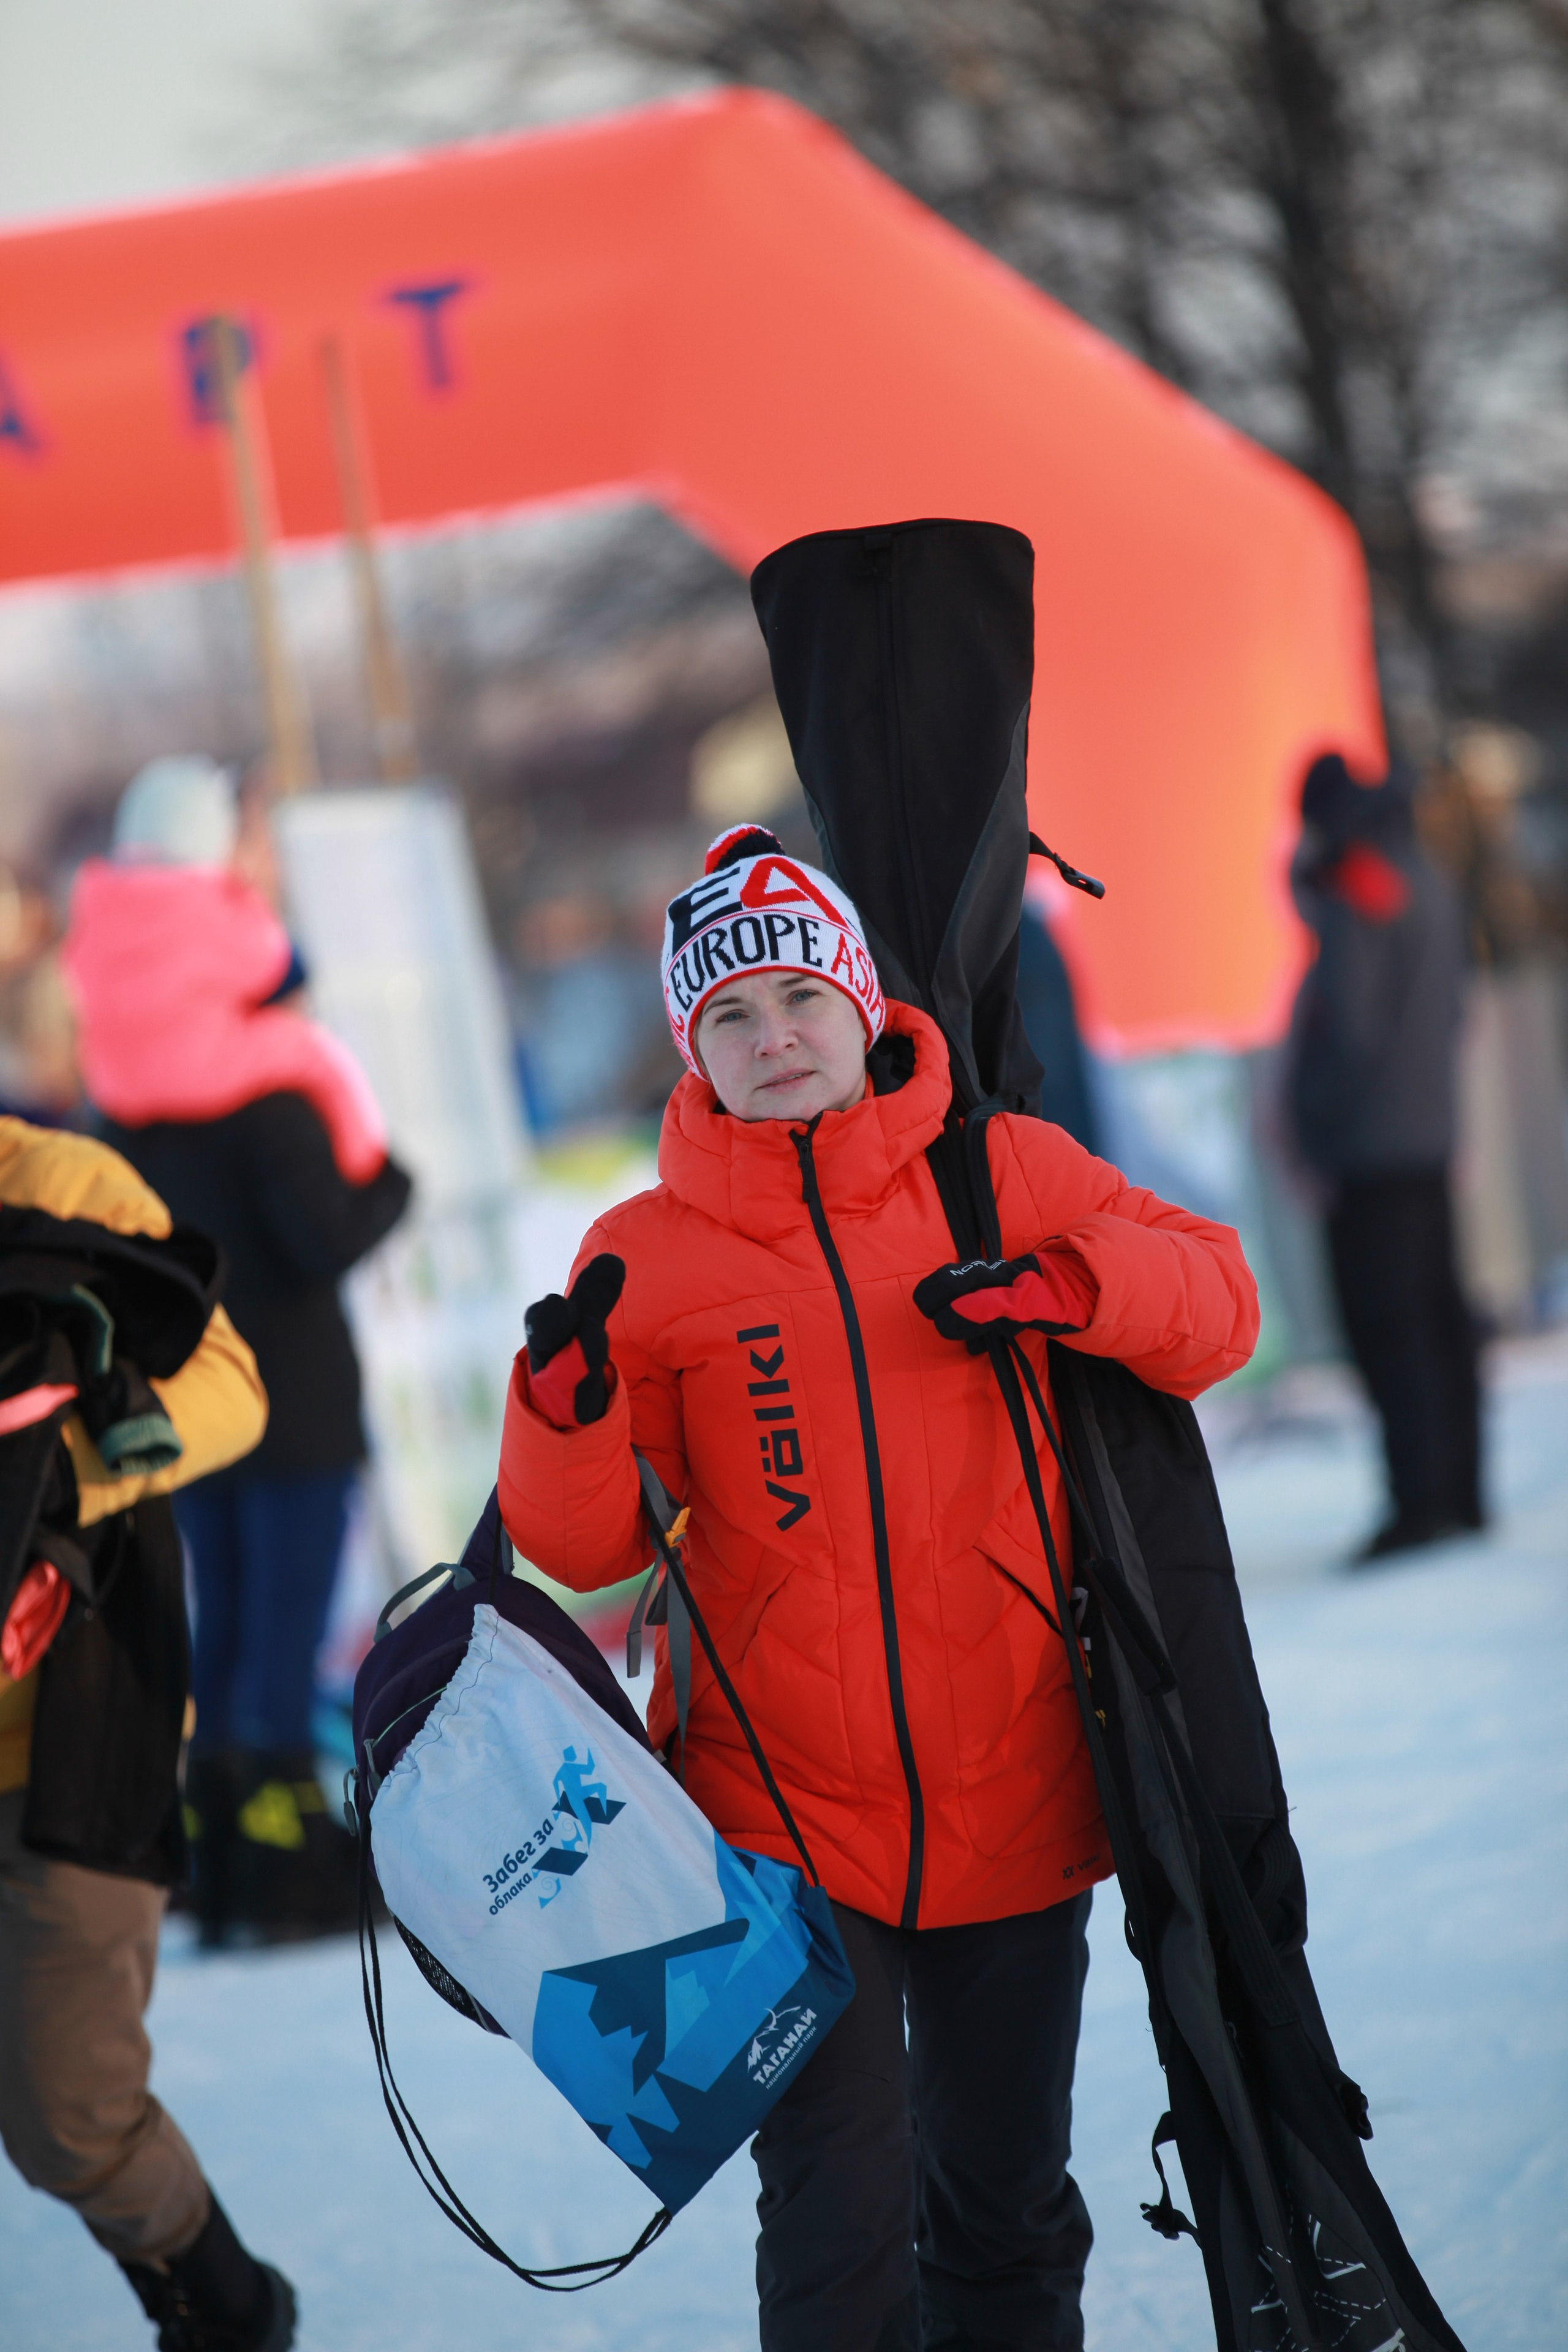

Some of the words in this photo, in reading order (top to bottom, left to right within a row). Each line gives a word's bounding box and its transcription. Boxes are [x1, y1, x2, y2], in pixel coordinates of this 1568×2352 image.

[669, 914, 822, 1012] EUROPE
[831, 932, 884, 1031] ASIA
[483, 1841, 537, 1893] Забег
[533, 1818, 554, 1845] за
[489, 1872, 533, 1915] облака
[753, 2008, 817, 2084] ТАГАНАЙ
[766, 2042, 804, 2090] национальный
[803, 2026, 817, 2043] парк
